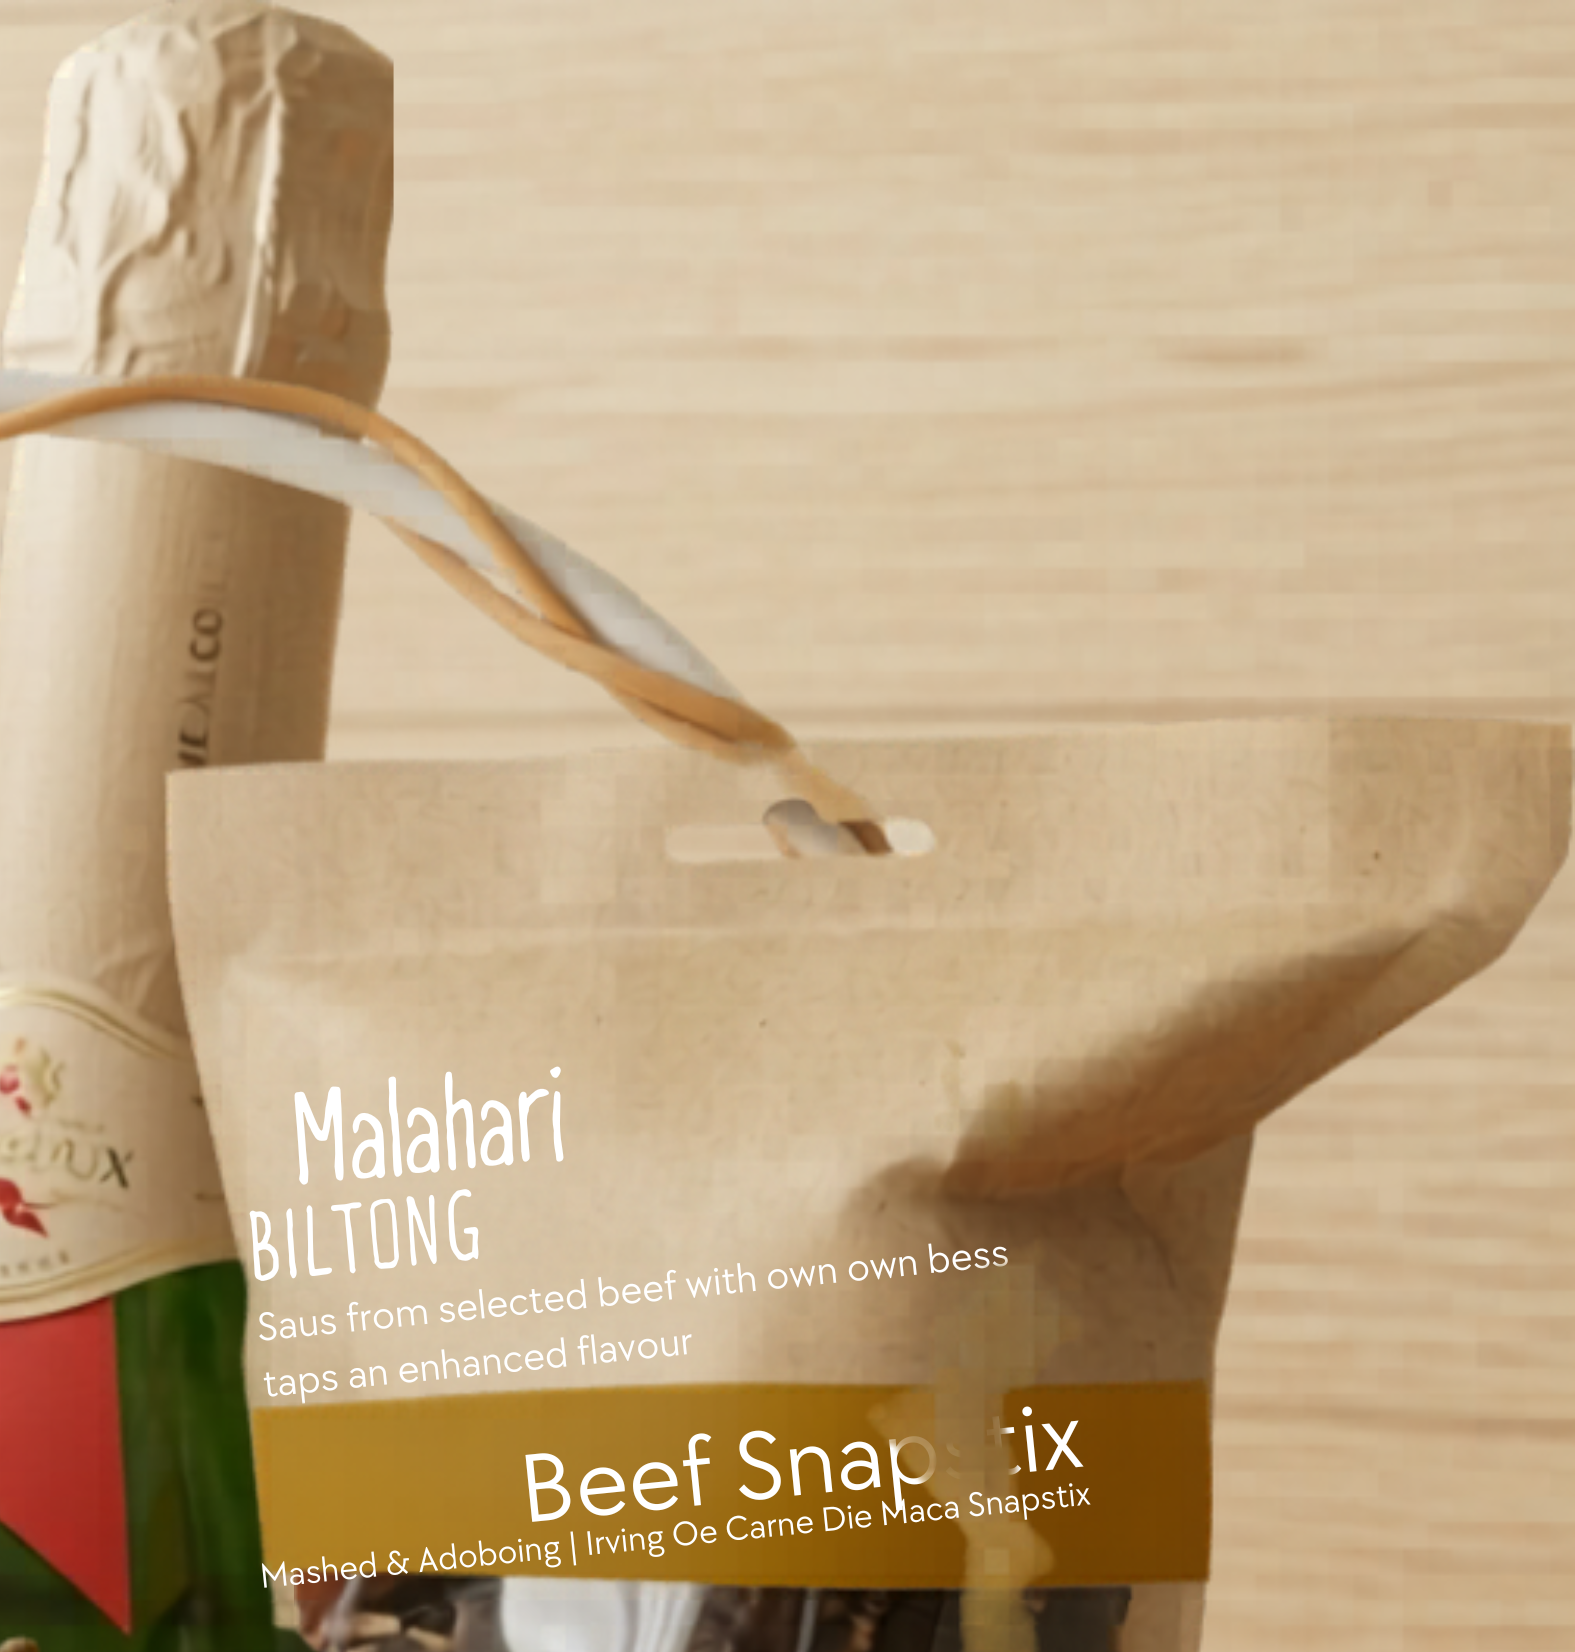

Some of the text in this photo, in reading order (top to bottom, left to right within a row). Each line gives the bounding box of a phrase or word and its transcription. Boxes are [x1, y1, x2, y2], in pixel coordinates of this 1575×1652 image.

[294, 1066, 564, 1185] Malahari
[249, 1188, 479, 1282] BILTONG
[258, 1243, 1009, 1341] Saus from selected beef with own own bess
[262, 1333, 693, 1404] taps an enhanced flavour
[525, 1405, 1085, 1527] Beef Snaptix
[260, 1551, 378, 1589] Mashed
[386, 1549, 411, 1577] &
[418, 1540, 563, 1574] Adoboing
[586, 1530, 666, 1559] Irving
[672, 1520, 718, 1547] Oe
[725, 1515, 814, 1542] Carne
[822, 1504, 873, 1533] Die
[881, 1498, 960, 1526] Maca
[968, 1482, 1092, 1521] Snapstix
